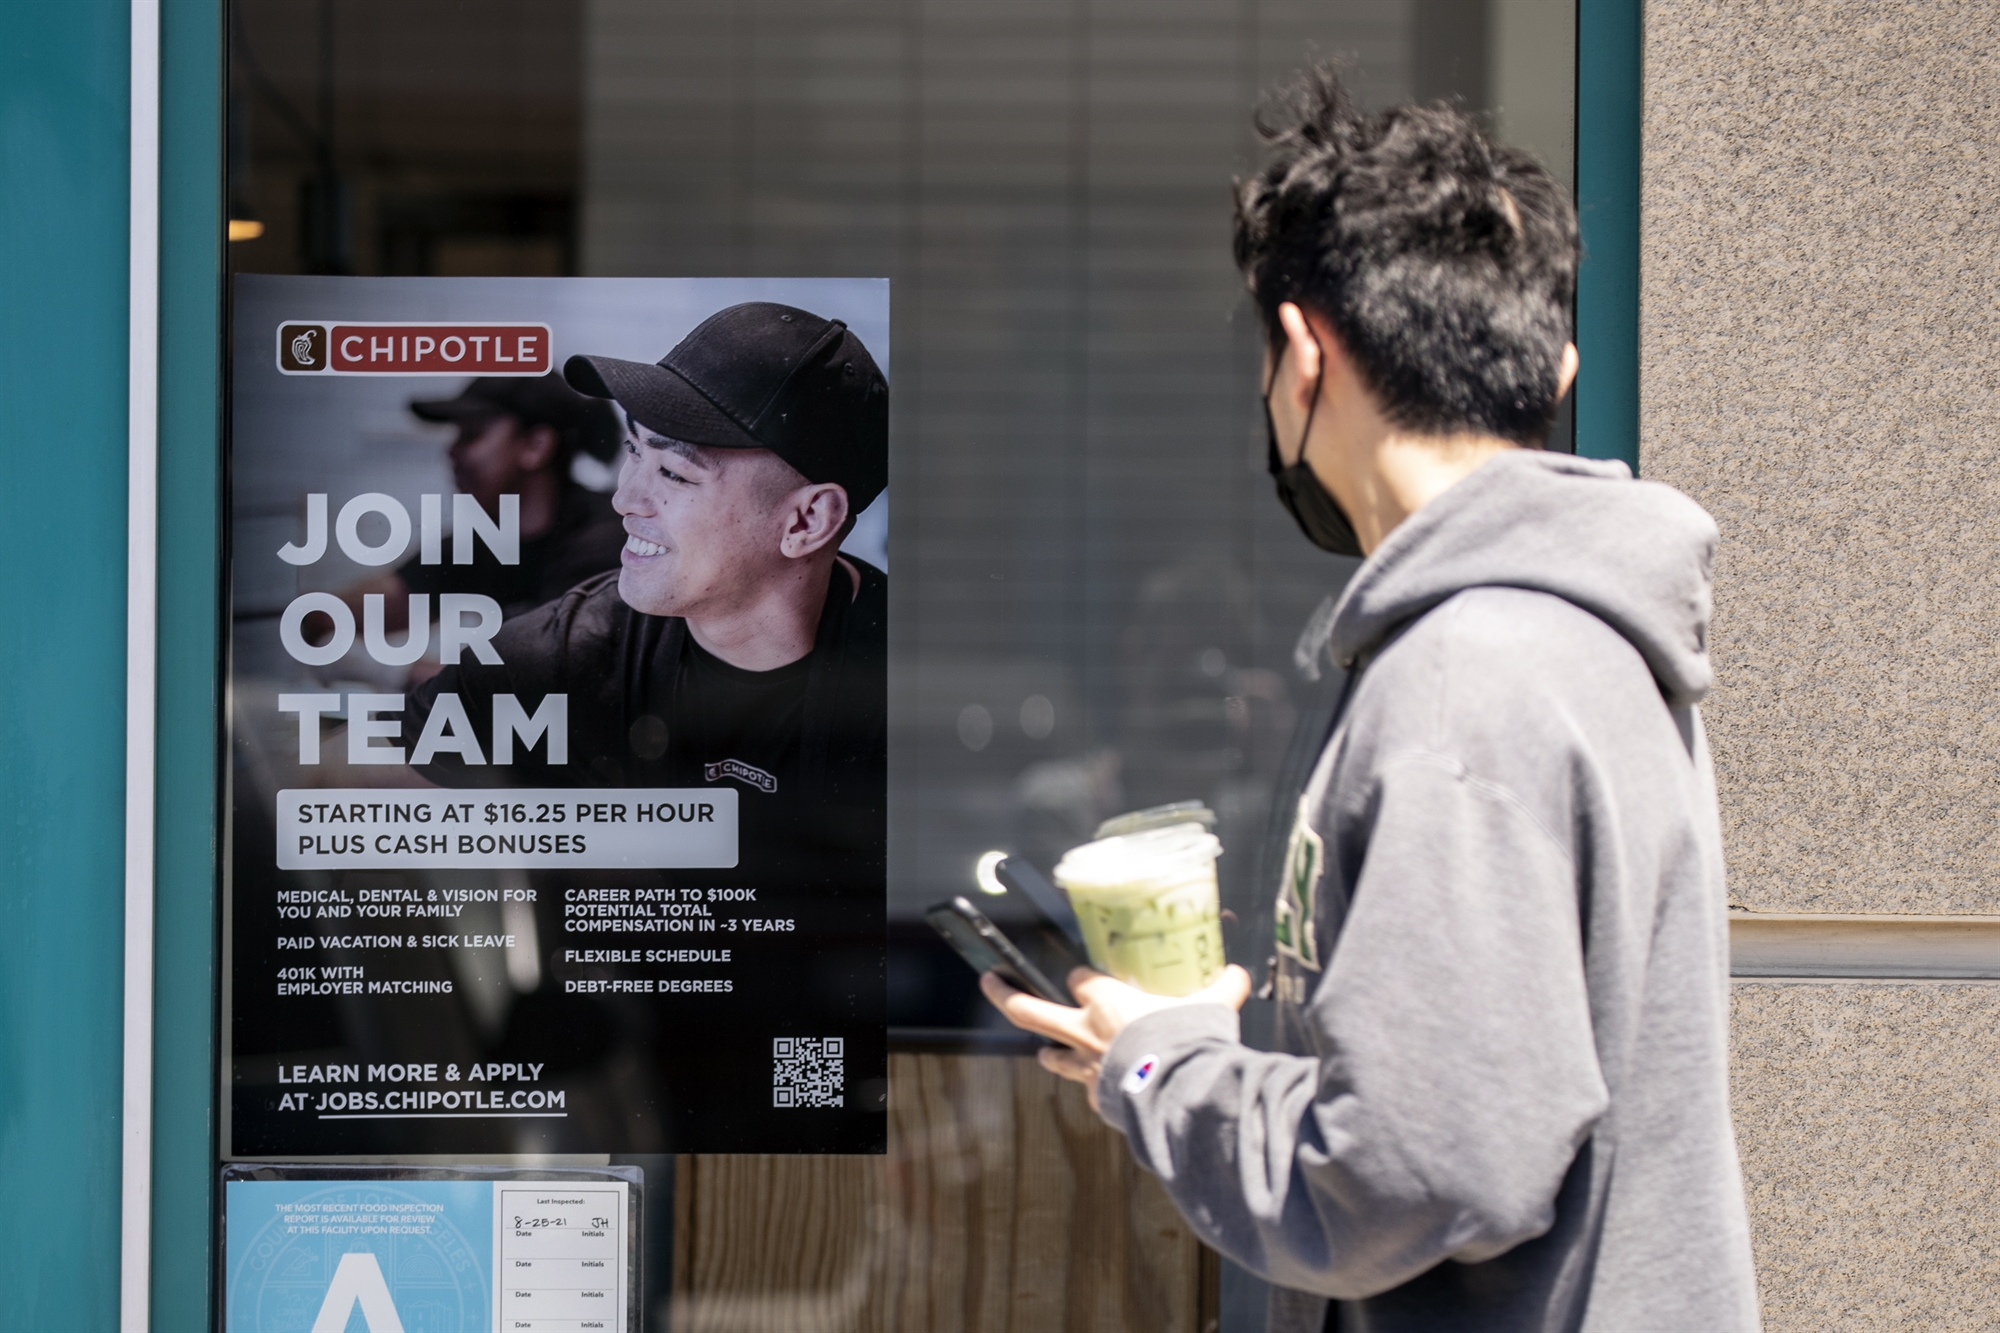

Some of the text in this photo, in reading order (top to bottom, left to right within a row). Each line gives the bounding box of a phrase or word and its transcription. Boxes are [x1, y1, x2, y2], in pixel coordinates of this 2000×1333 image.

[340, 335, 538, 363] CHIPOTLE
[277, 492, 521, 567] JOIN
[279, 591, 505, 667] OUR
[277, 693, 569, 766] TEAM
[723, 763, 772, 789] CHIPOTLE
[298, 802, 715, 826] STARTING AT $16.25 PER HOUR
[298, 834, 587, 855] PLUS CASH BONUSES
[277, 888, 537, 904] MEDICAL, DENTAL & VISION FOR
[564, 887, 757, 903] CAREER PATH TO $100K
[277, 904, 464, 919] YOU AND YOUR FAMILY
[565, 903, 713, 917] POTENTIAL TOTAL
[564, 918, 796, 932] COMPENSATION IN ~3 YEARS
[277, 934, 516, 950] PAID VACATION & SICK LEAVE
[565, 949, 732, 963] FLEXIBLE SCHEDULE
[277, 966, 364, 981] 401K WITH
[277, 980, 453, 996] EMPLOYER MATCHING
[565, 979, 734, 993] DEBT-FREE DEGREES
[278, 1063, 544, 1084] LEARN MORE & APPLY
[278, 1090, 566, 1112] AT JOBS.CHIPOTLE.COM
[275, 1204, 444, 1213] THE MOST RECENT FOOD INSPECTION
[284, 1215, 435, 1223] REPORT IS AVAILABLE FOR REVIEW
[514, 1216, 567, 1229] 8-25-21
[287, 1226, 432, 1235] AT THIS FACILITY UPON REQUEST.
